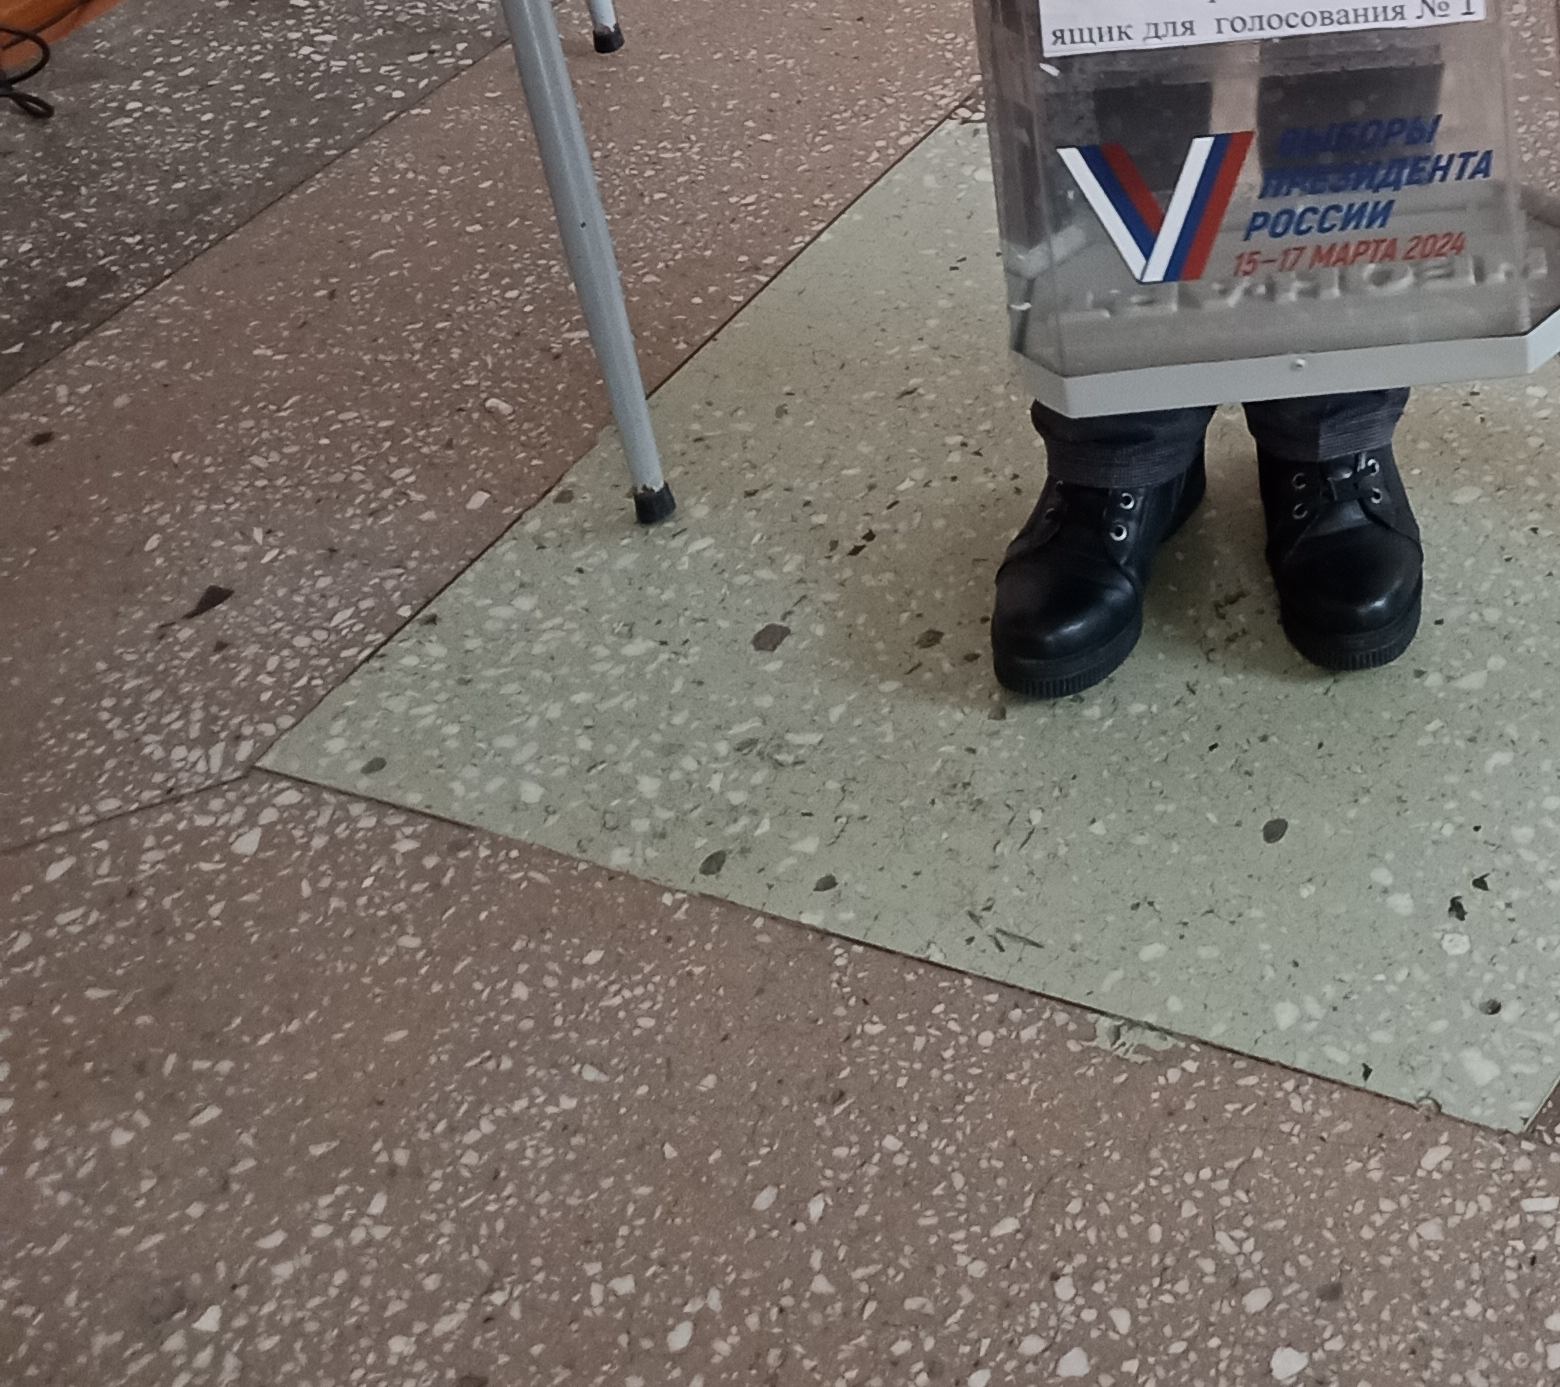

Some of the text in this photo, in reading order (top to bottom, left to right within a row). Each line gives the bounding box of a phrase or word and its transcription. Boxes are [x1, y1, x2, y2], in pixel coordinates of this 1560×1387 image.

[1051, 23, 1134, 46] ящик
[1142, 19, 1196, 42] для
[1214, 3, 1408, 35] голосования
[1277, 114, 1443, 158] ВЫБОРЫ
[1258, 149, 1494, 199] ПРЕЗИДЕНТА
[1243, 199, 1395, 241] РОССИИ
[1309, 237, 1399, 269] МАРТА
[1402, 231, 1466, 261] 2024
